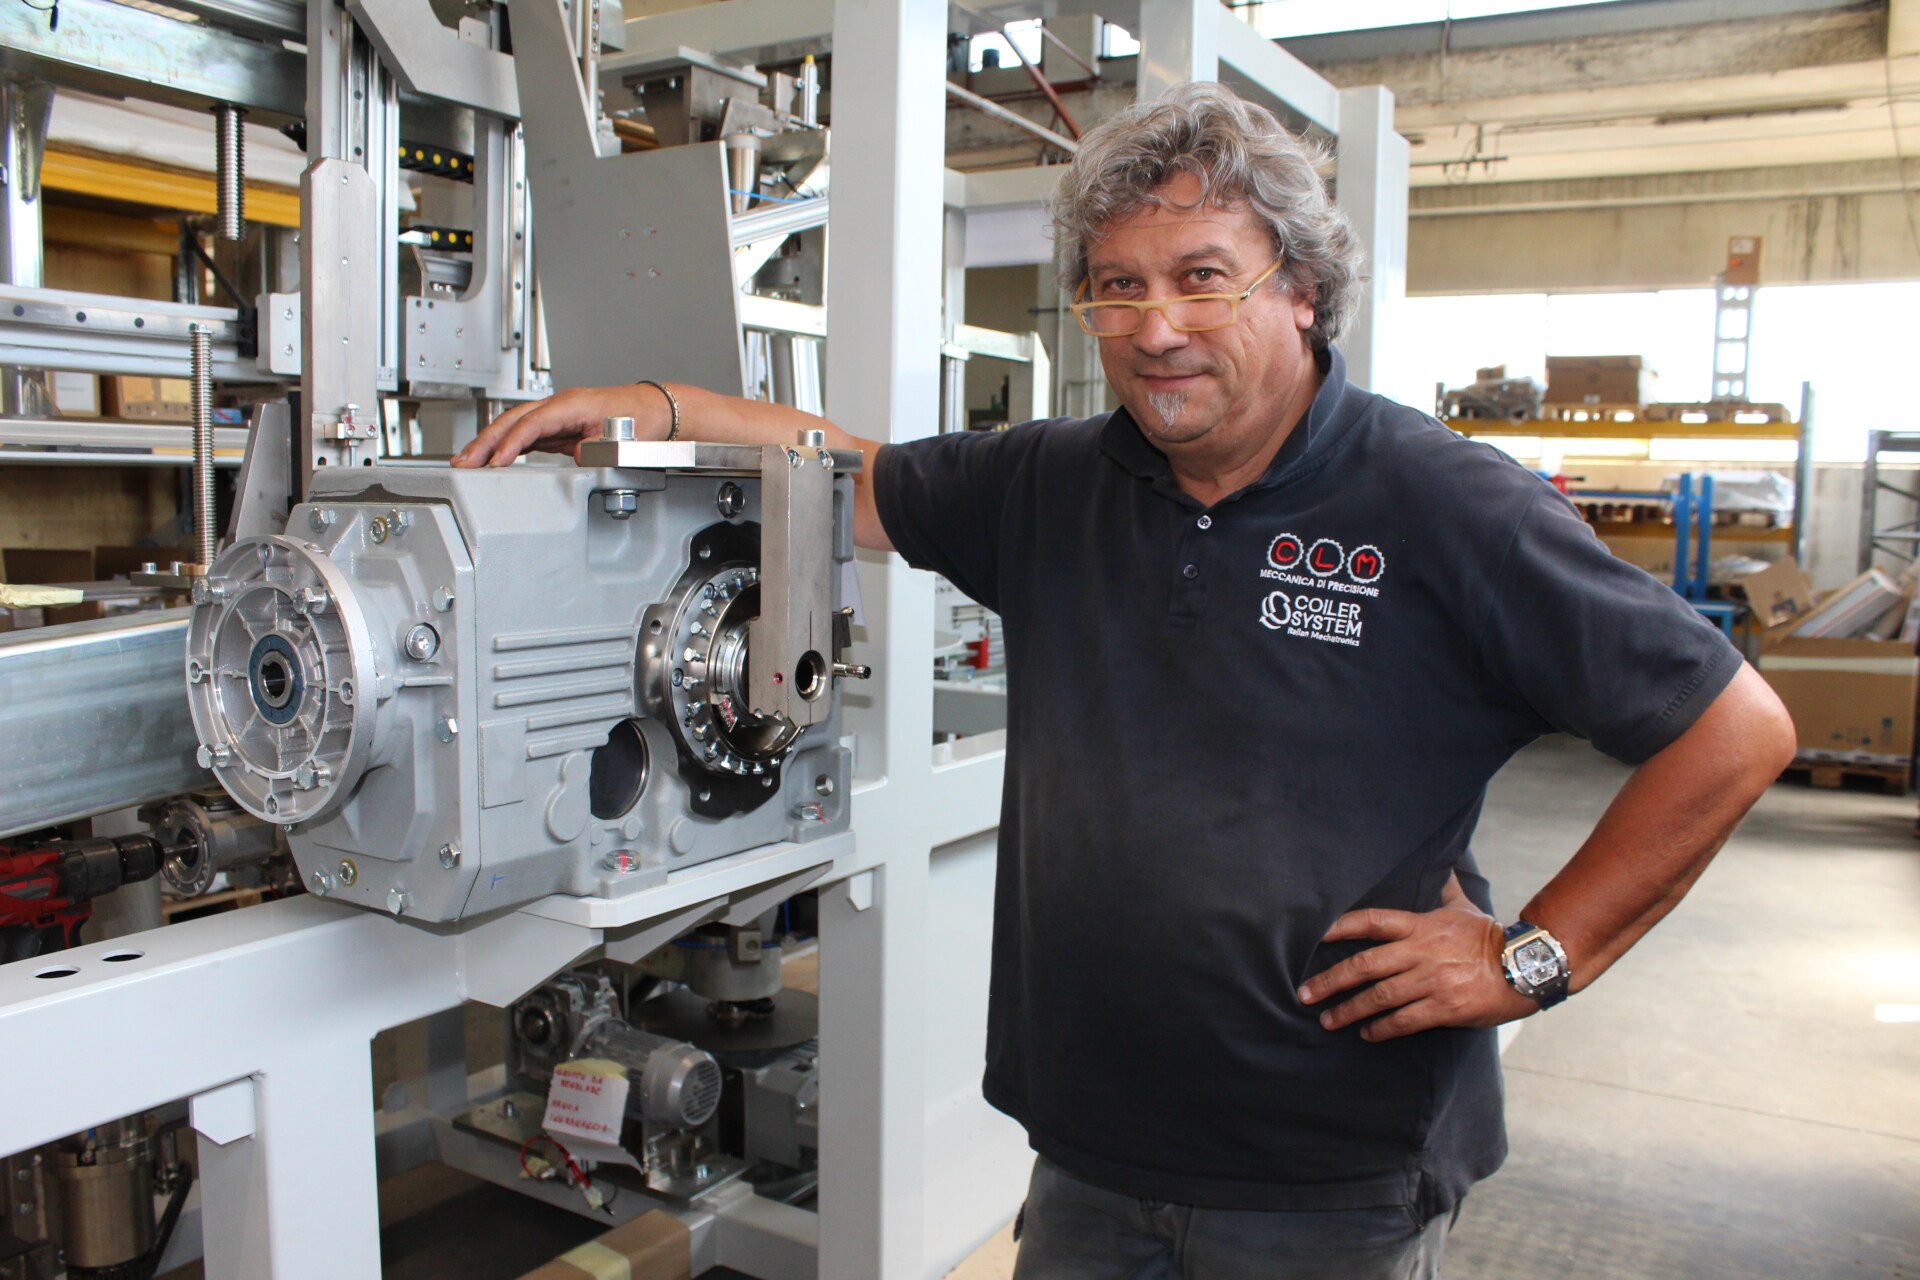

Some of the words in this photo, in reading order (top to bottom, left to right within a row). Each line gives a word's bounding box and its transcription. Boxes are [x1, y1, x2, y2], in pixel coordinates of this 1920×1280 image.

[1260, 569, 1315, 587] MECCANICA
[1316, 579, 1326, 589] DI
[1327, 580, 1380, 598] PRECISIONE
[1294, 595, 1361, 621] COILER
[1287, 626, 1310, 638] Italian
[1310, 630, 1360, 647] Mechatronics
[1290, 610, 1363, 638] SYSTEM
